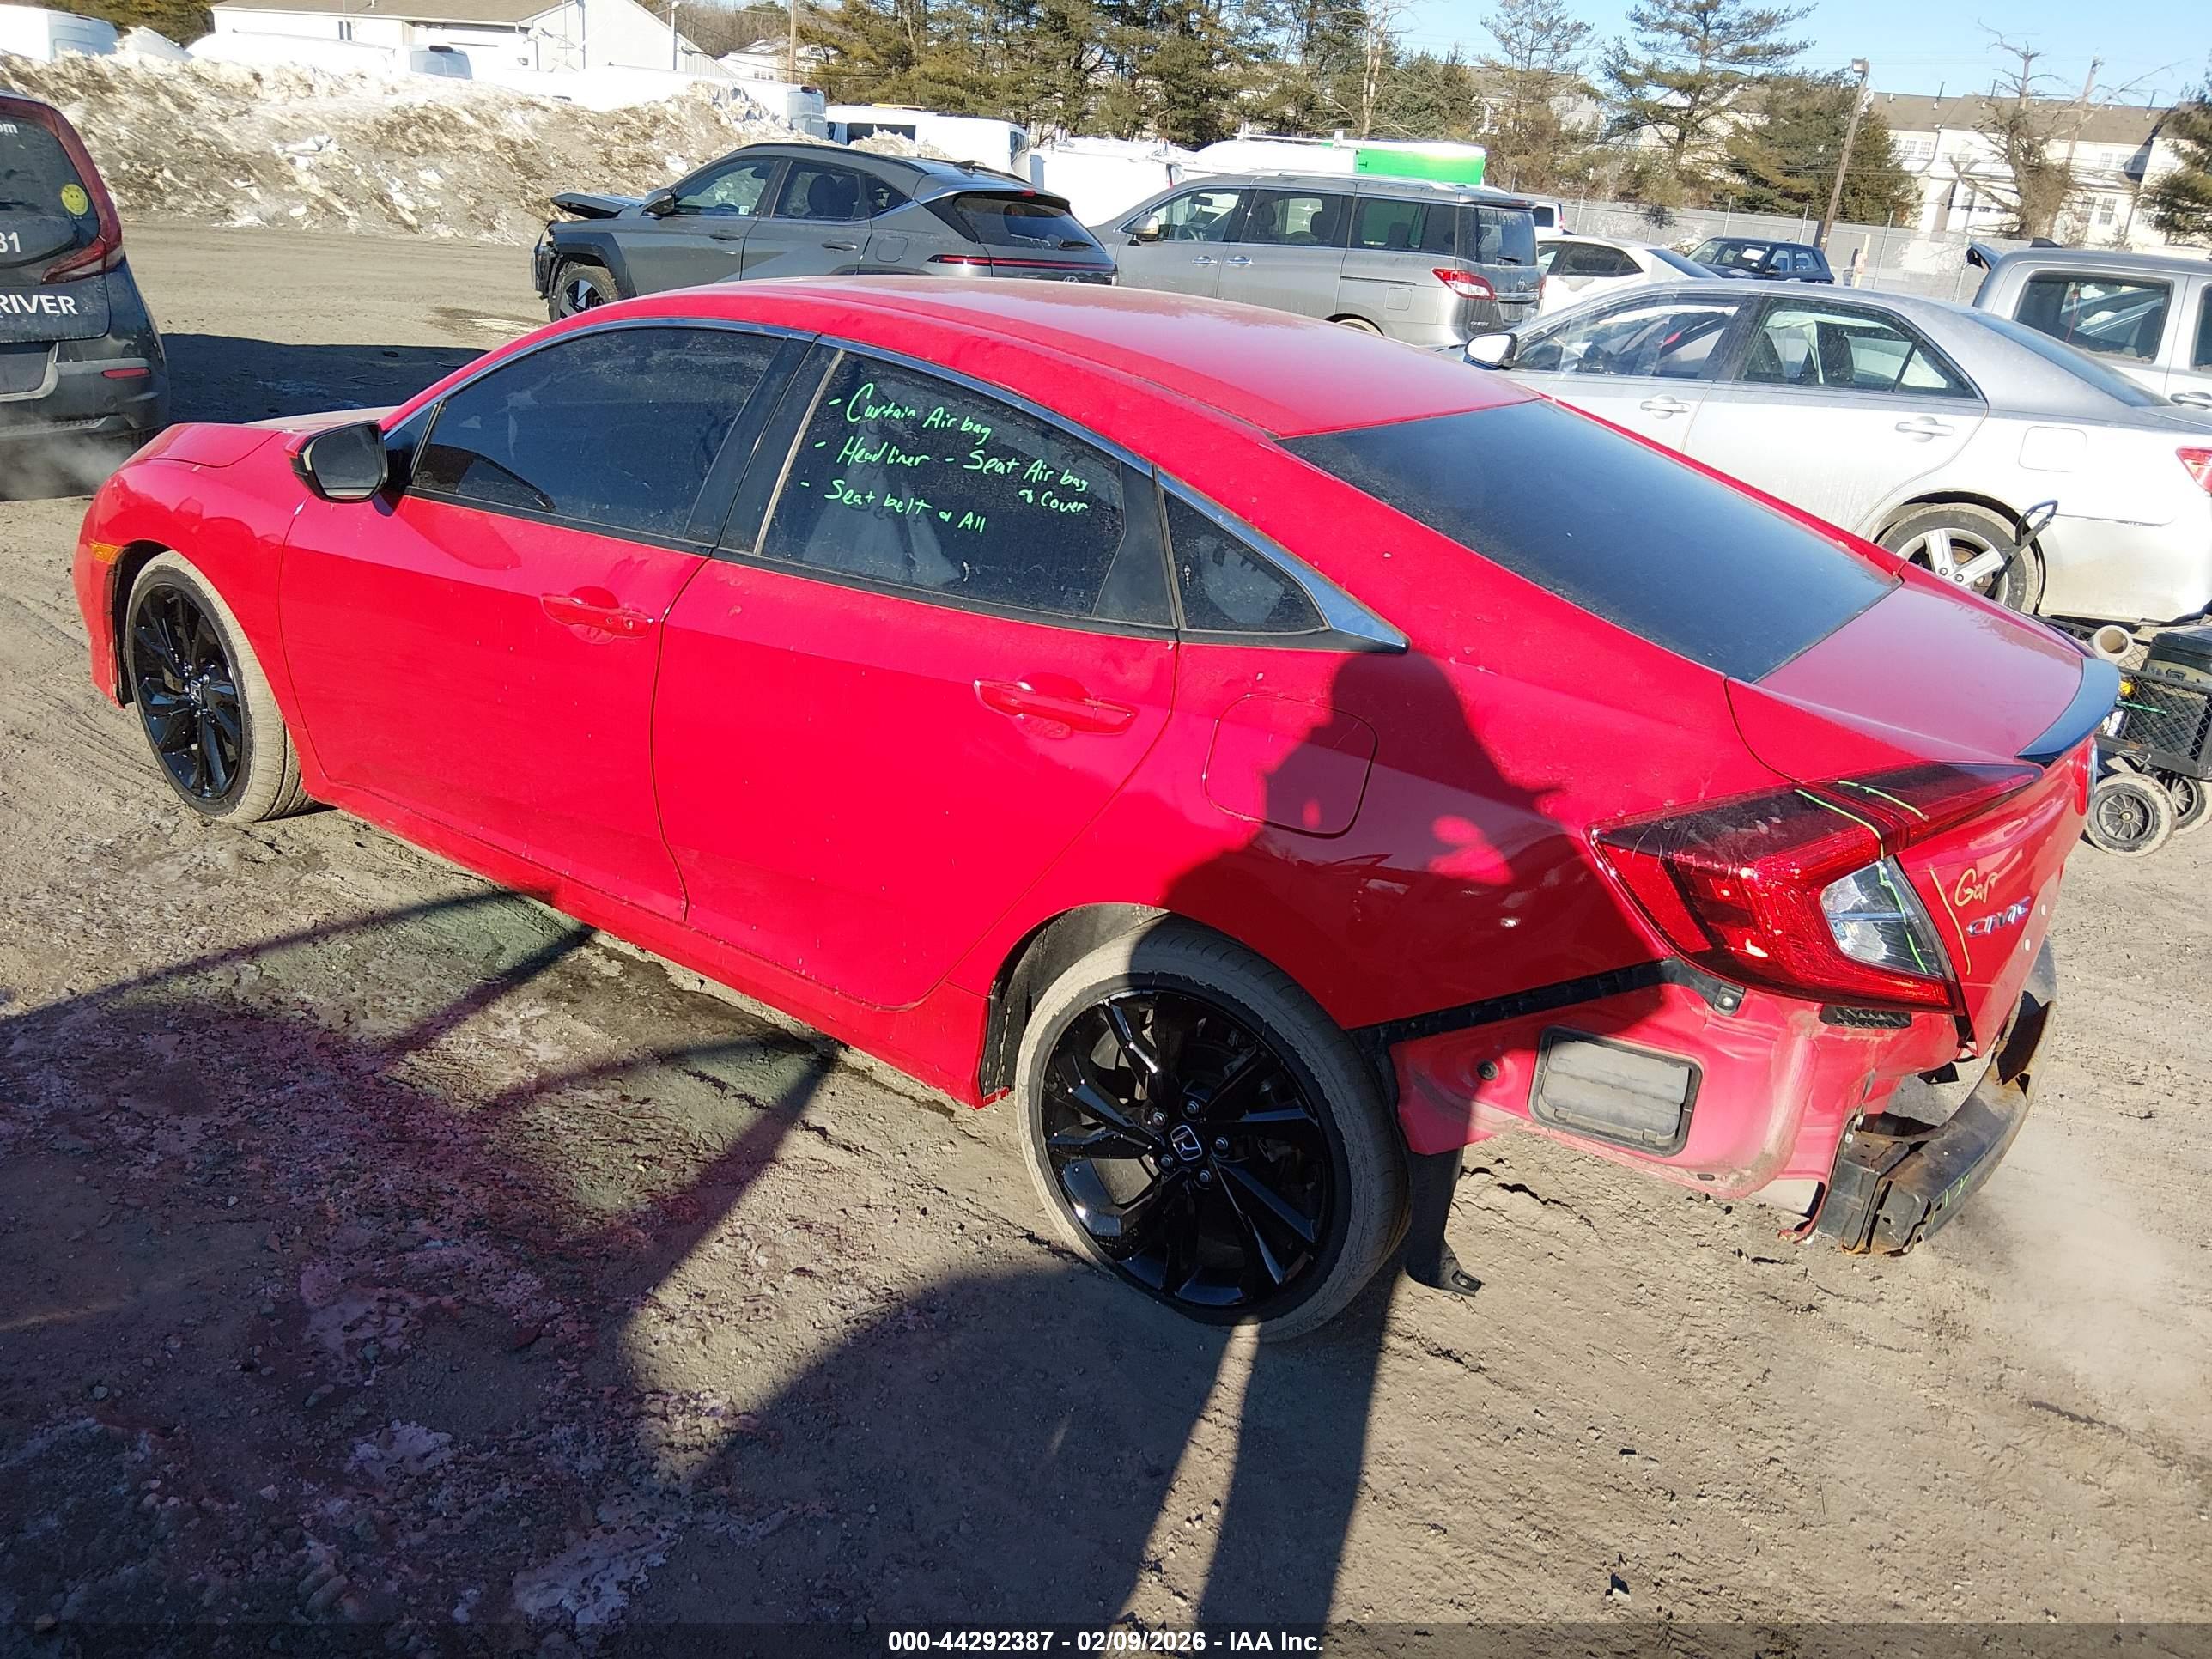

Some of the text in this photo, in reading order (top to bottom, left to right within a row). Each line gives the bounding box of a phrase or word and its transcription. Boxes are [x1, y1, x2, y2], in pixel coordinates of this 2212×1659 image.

[846, 383, 915, 422] Curtain
[963, 449, 1020, 474] Seat
[824, 479, 876, 505] Seat
[884, 493, 933, 515] belt
[957, 512, 987, 533] All
[1040, 491, 1089, 513] Cover
